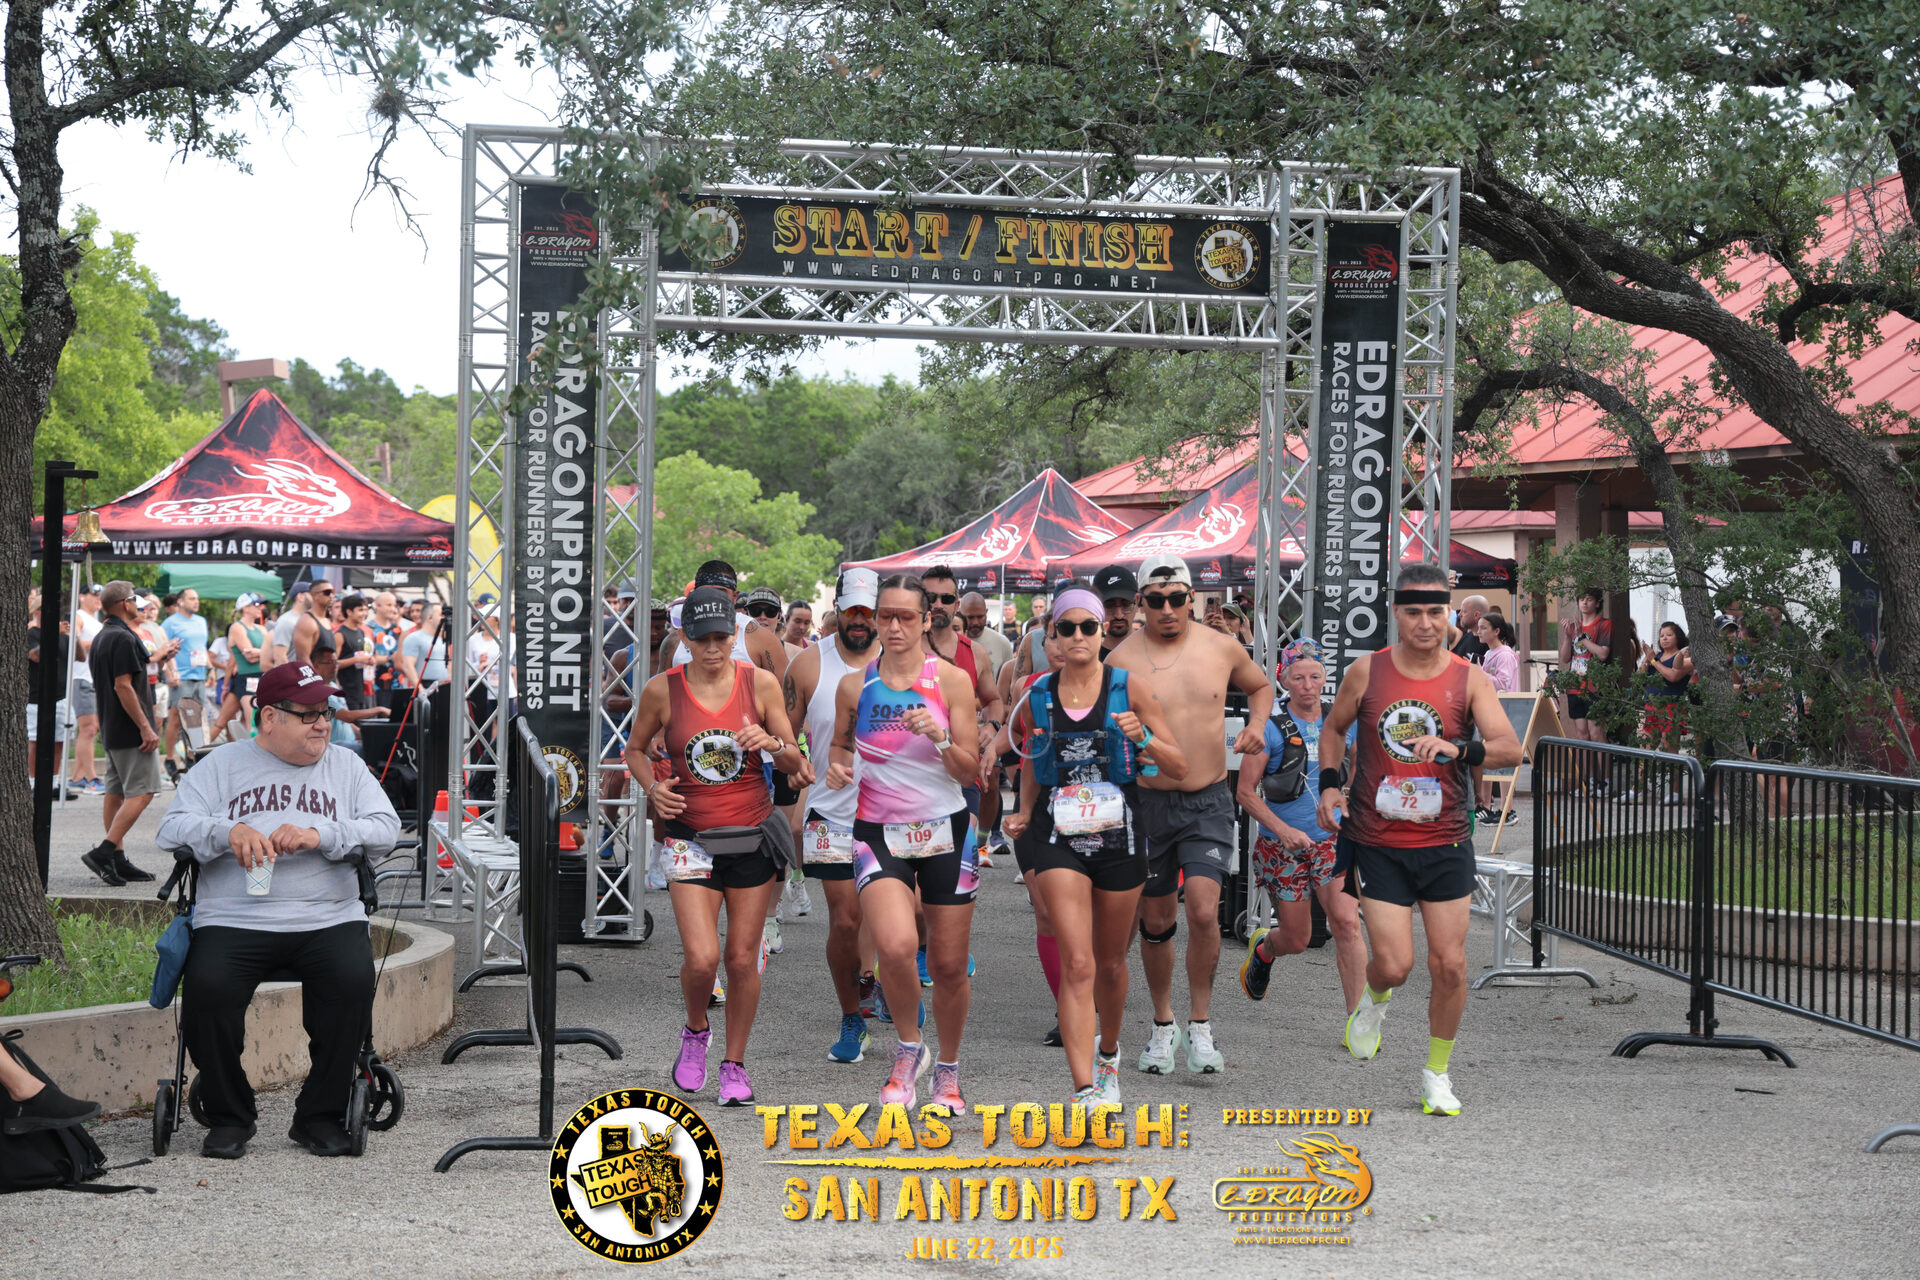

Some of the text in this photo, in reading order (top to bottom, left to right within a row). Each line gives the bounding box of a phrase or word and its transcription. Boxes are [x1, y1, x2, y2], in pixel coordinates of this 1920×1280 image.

[773, 205, 1174, 271] START / FINISH
[1202, 224, 1255, 243] TEXAS TOUGH
[1330, 342, 1350, 414] RACES
[1328, 422, 1348, 468] FOR
[526, 451, 546, 558] RUNNERS
[1324, 475, 1346, 577] RUNNERS
[112, 540, 379, 561] WWW.EDRAGONPRO.NET
[526, 566, 544, 595] BY
[694, 602, 722, 613] WTF!
[1324, 585, 1342, 612] BY
[526, 602, 544, 710] RUNNERS
[228, 784, 337, 821] TEXAS A&M
[1079, 804, 1096, 817] 77
[1401, 796, 1418, 808] 72
[817, 838, 830, 850] 88
[905, 829, 932, 843] 109
[673, 855, 688, 866] 71
